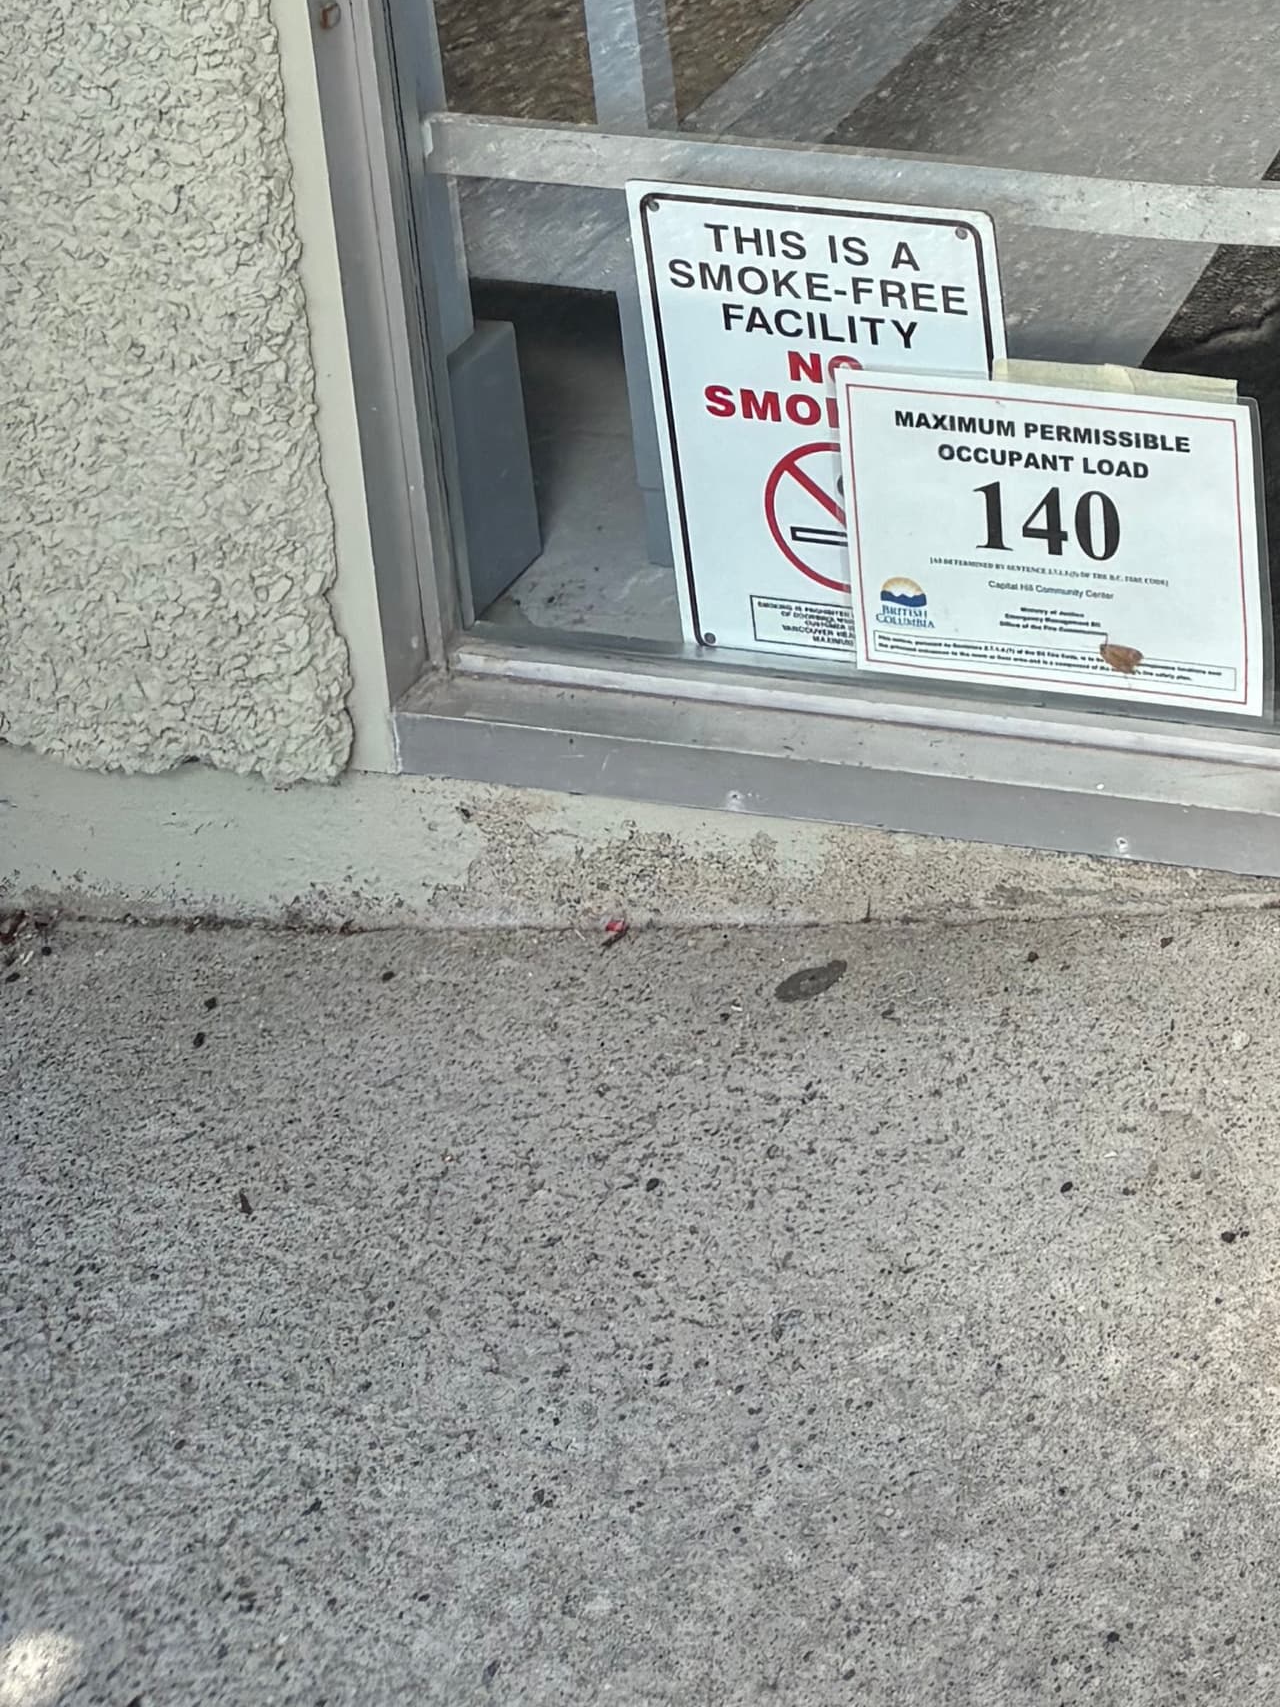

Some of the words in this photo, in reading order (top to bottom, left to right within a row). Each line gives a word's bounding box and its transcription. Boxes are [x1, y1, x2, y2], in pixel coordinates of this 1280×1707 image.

[703, 222, 808, 261] THIS
[827, 234, 870, 267] IS
[890, 240, 921, 272] A
[667, 258, 969, 317] SMOKE-FREE
[721, 302, 918, 349] FACILITY
[894, 410, 1016, 438] MAXIMUM
[1023, 421, 1191, 453] PERMISSIBLE
[938, 443, 1075, 472] OCCUPANT
[1082, 456, 1149, 479] LOAD
[972, 480, 1121, 561] 140
[943, 558, 994, 569] DETERMINED
[1006, 564, 1046, 574] SENTENCE
[881, 604, 928, 619] BRITISH
[1035, 585, 1083, 599] Community
[875, 613, 936, 629] COLUMBIA
